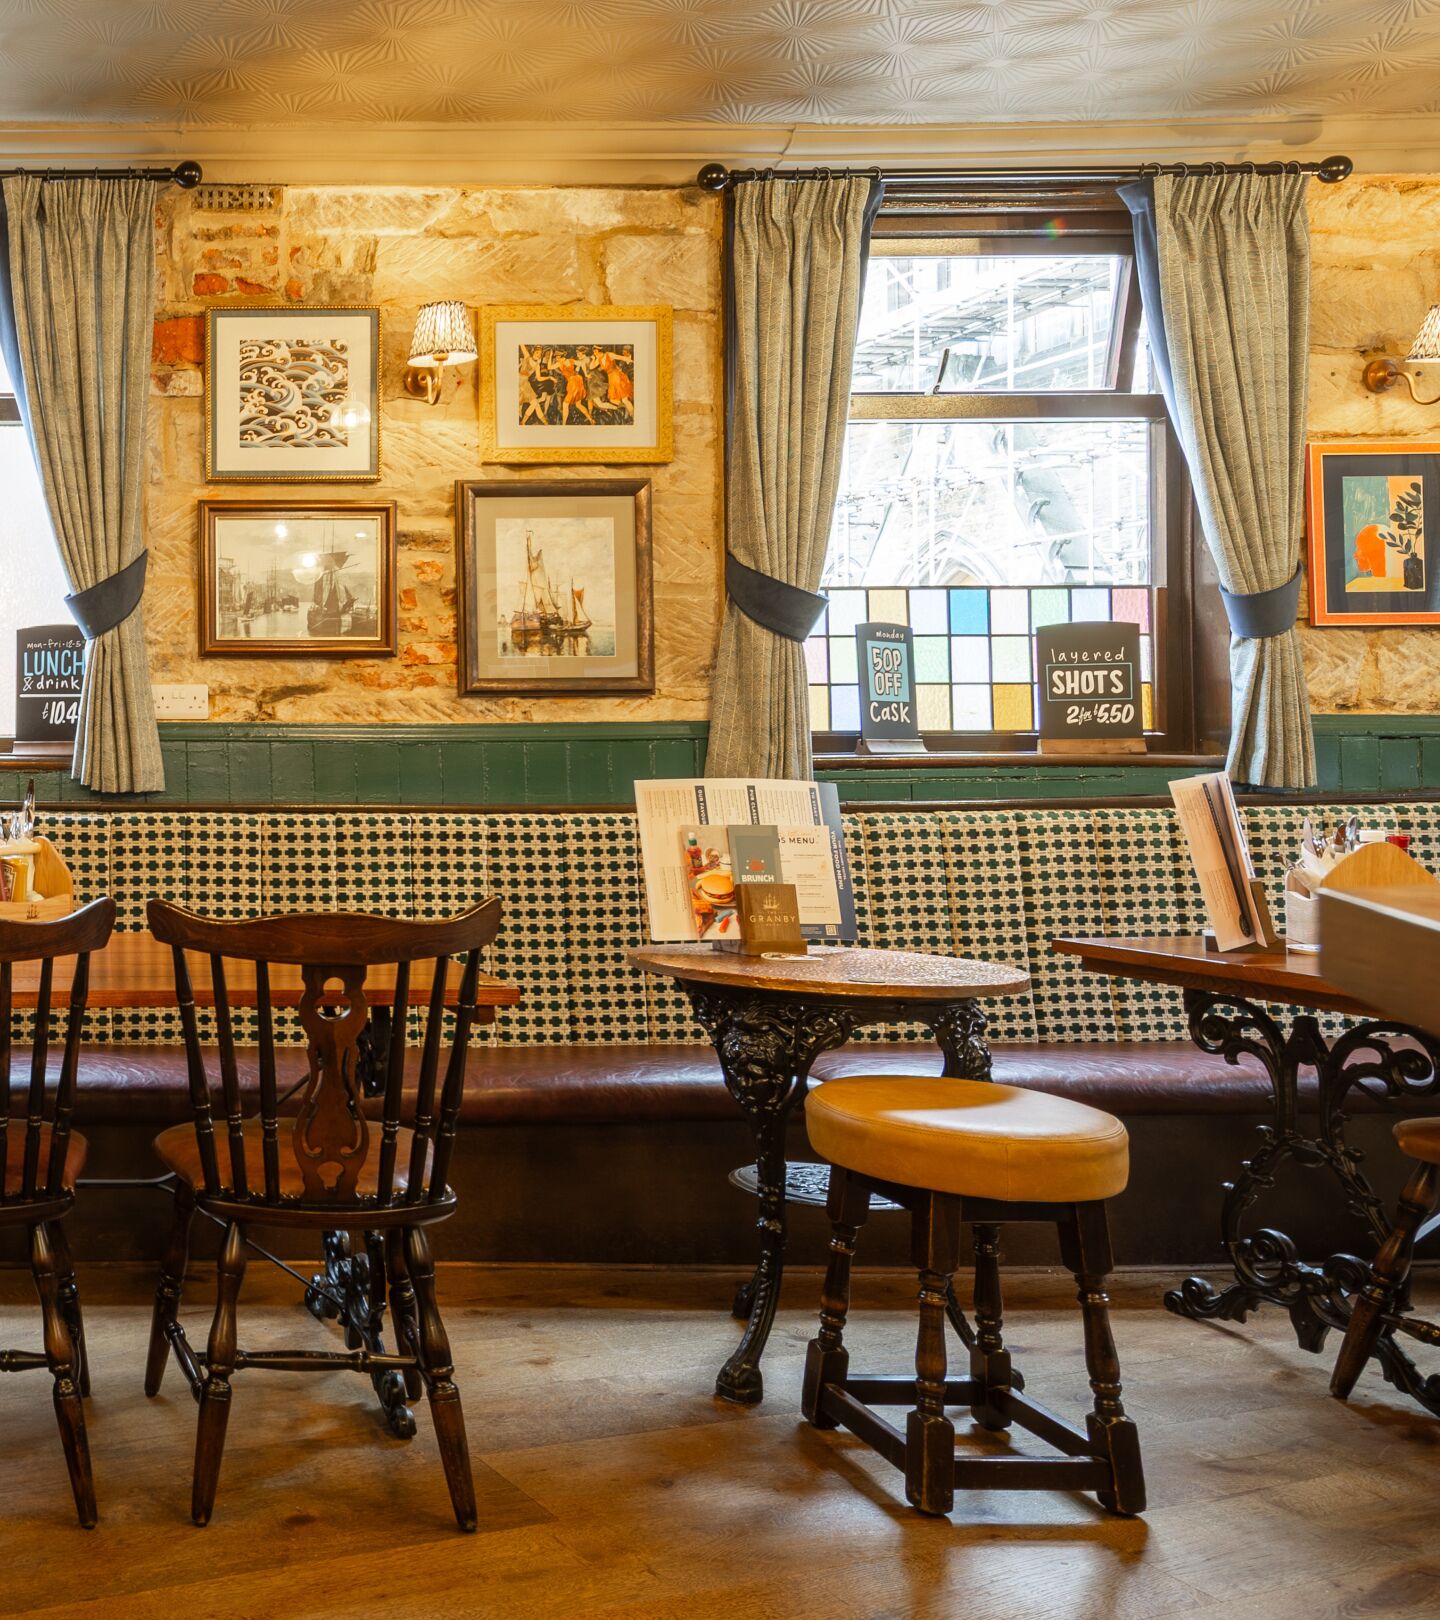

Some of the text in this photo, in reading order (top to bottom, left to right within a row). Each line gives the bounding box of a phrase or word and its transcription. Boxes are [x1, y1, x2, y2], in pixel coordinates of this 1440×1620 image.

[875, 629, 905, 641] monday
[23, 649, 85, 677] LUNCH
[871, 646, 903, 672] 50P
[1051, 647, 1125, 664] layered
[22, 674, 80, 692] & drink
[874, 671, 903, 697] OFF
[1052, 670, 1124, 695] SHOTS
[42, 700, 79, 725] £10.4
[1066, 705, 1079, 724] 2
[1078, 706, 1093, 725] for
[789, 837, 815, 845] MENU
[830, 830, 838, 849] YOUR
[835, 868, 844, 890] MENU
[741, 874, 775, 883] BRUNCH
[749, 914, 796, 924] GRANBY
